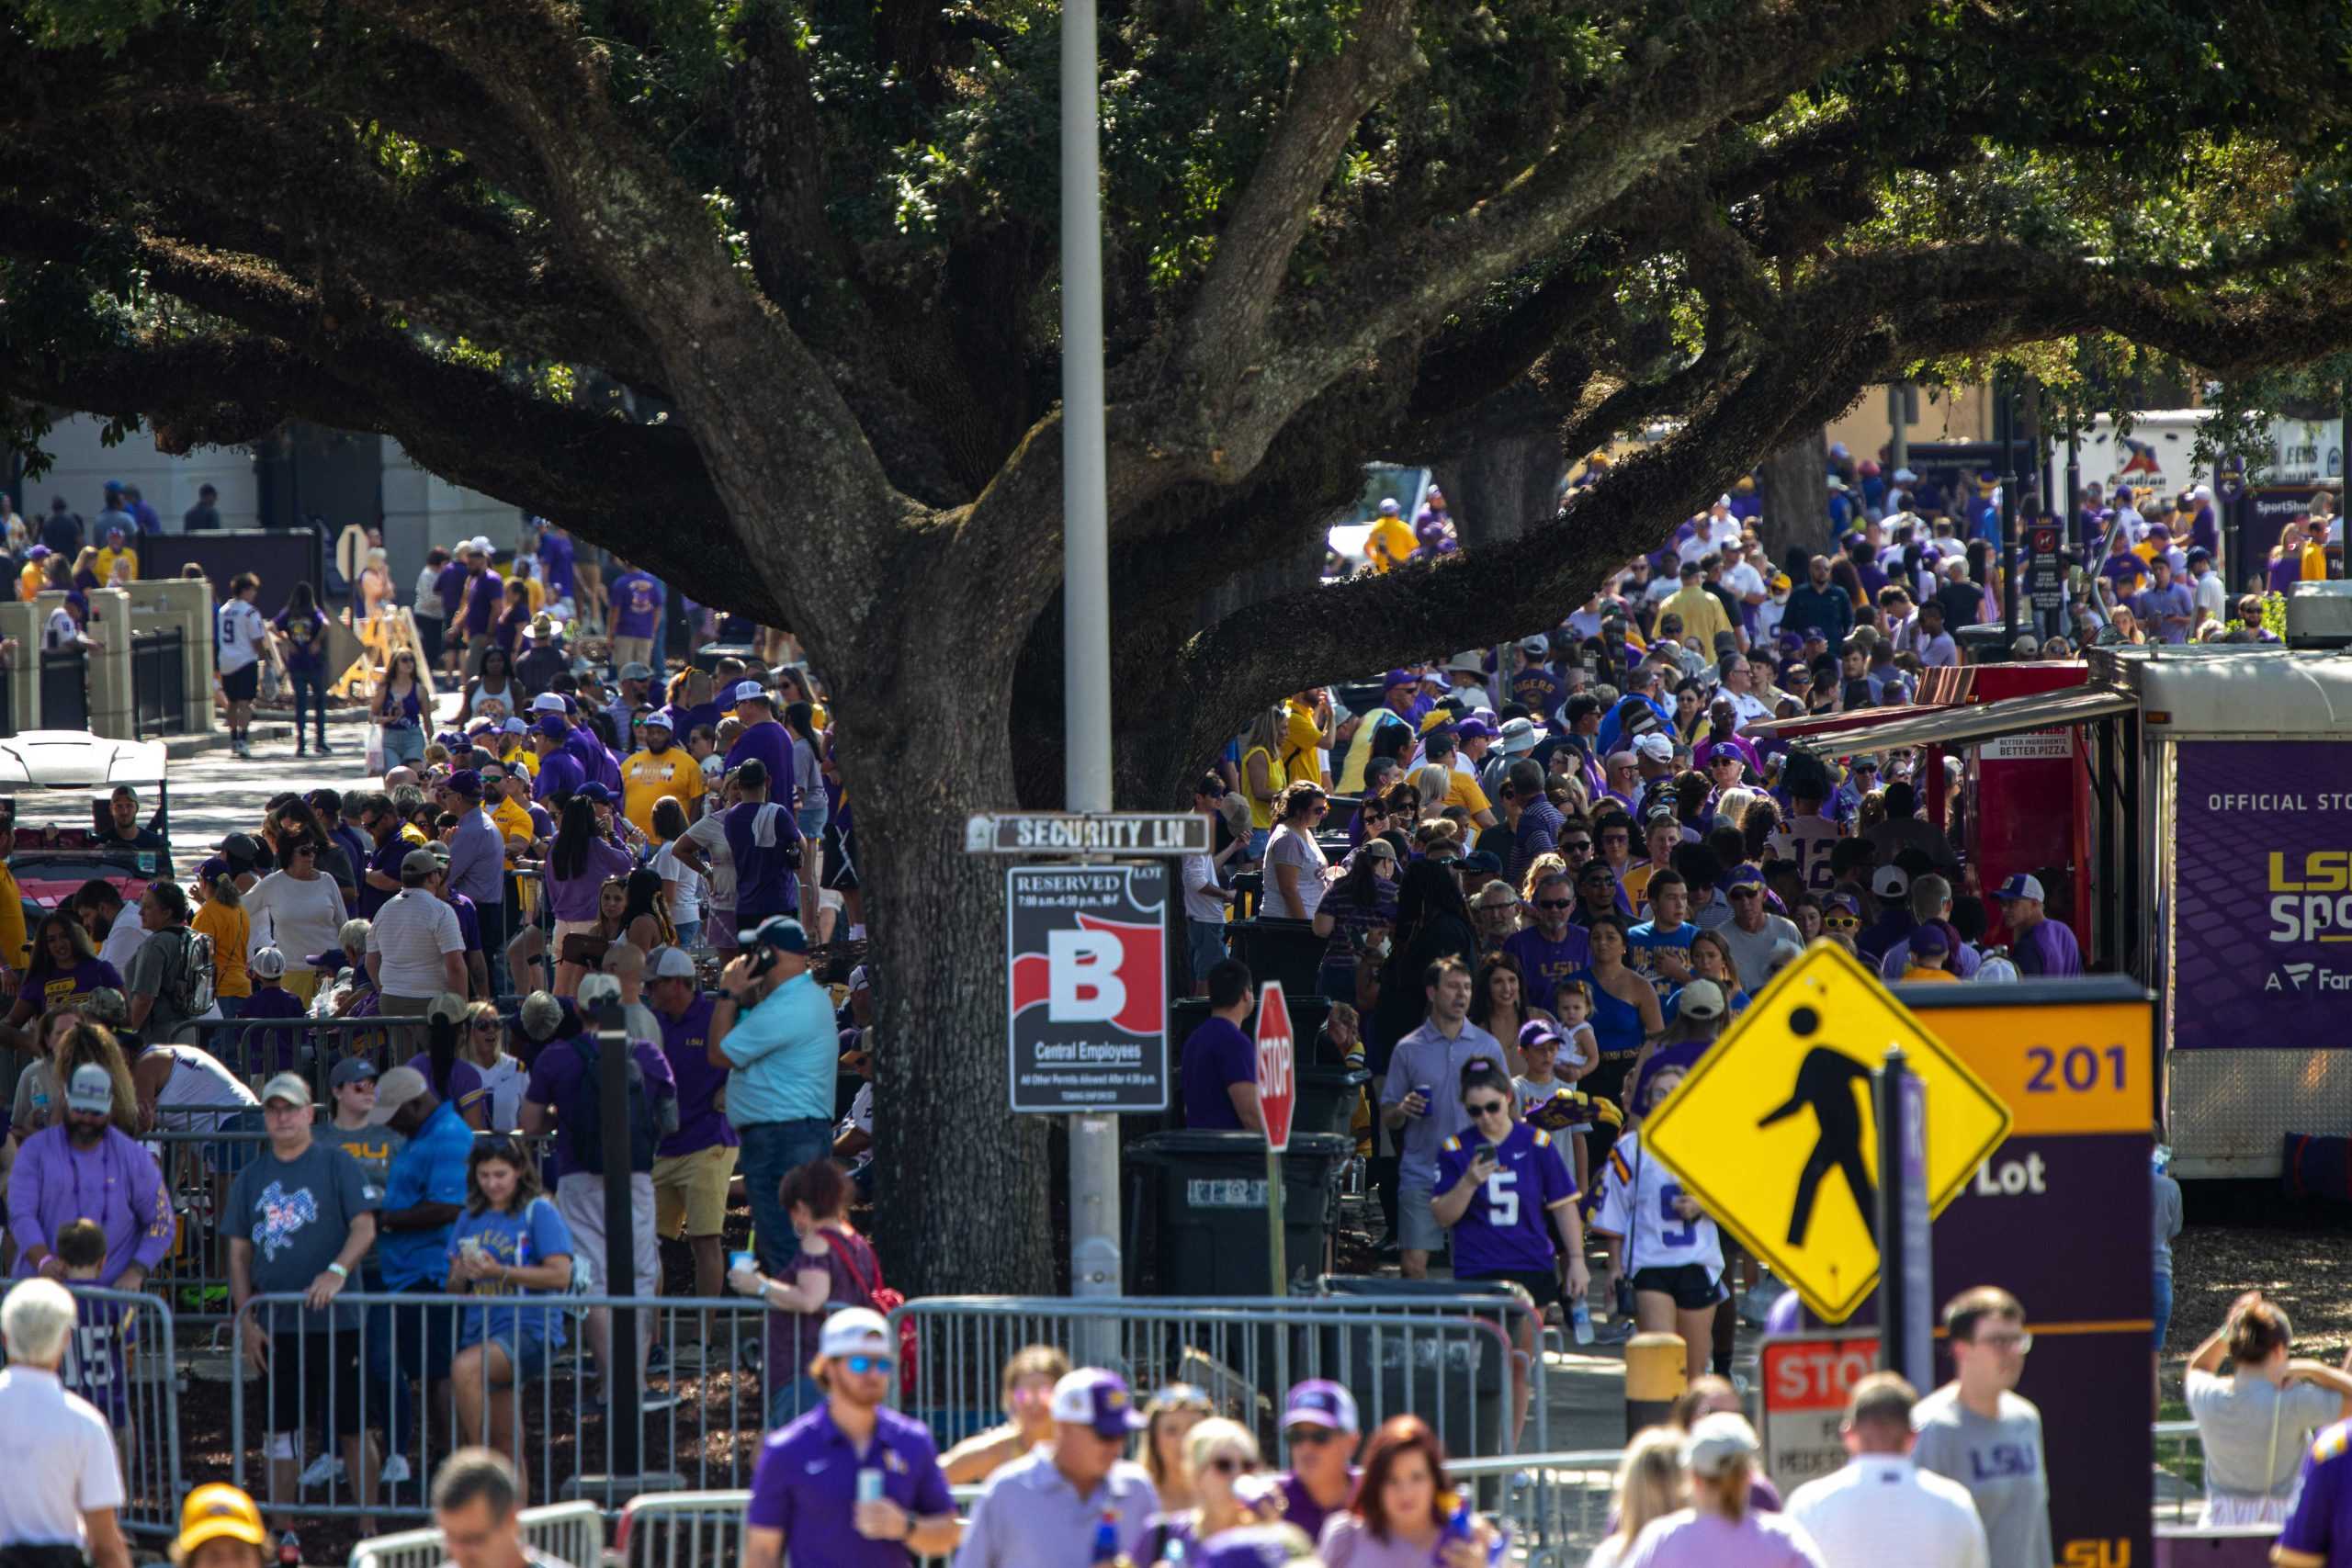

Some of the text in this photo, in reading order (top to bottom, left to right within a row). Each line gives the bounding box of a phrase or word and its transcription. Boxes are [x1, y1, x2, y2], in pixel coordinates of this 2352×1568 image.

[2107, 474, 2166, 485] Acadian
[223, 618, 235, 644] 9
[2000, 746, 2068, 756] BETTER PIZZA.
[2209, 794, 2308, 811] OFFICIAL
[1017, 820, 1185, 847] SECURITY LN
[1134, 867, 1162, 879] LOT
[1793, 838, 1836, 889] 12
[2268, 852, 2352, 892] LS
[1017, 875, 1121, 893] RESERVED
[1018, 895, 1036, 907] 7:00
[1048, 930, 1127, 1022] B
[1541, 961, 1581, 976] LSU
[2265, 973, 2282, 991] A
[1035, 1041, 1141, 1062] Central Employees
[1032, 1074, 1051, 1086] Other
[1260, 1037, 1291, 1098] STOP
[2026, 1044, 2125, 1093] 201
[1977, 1151, 2047, 1196] Lot
[1488, 1172, 1520, 1226] 5
[1969, 1445, 2037, 1481] LSU
[2053, 1538, 2132, 1568] SU
